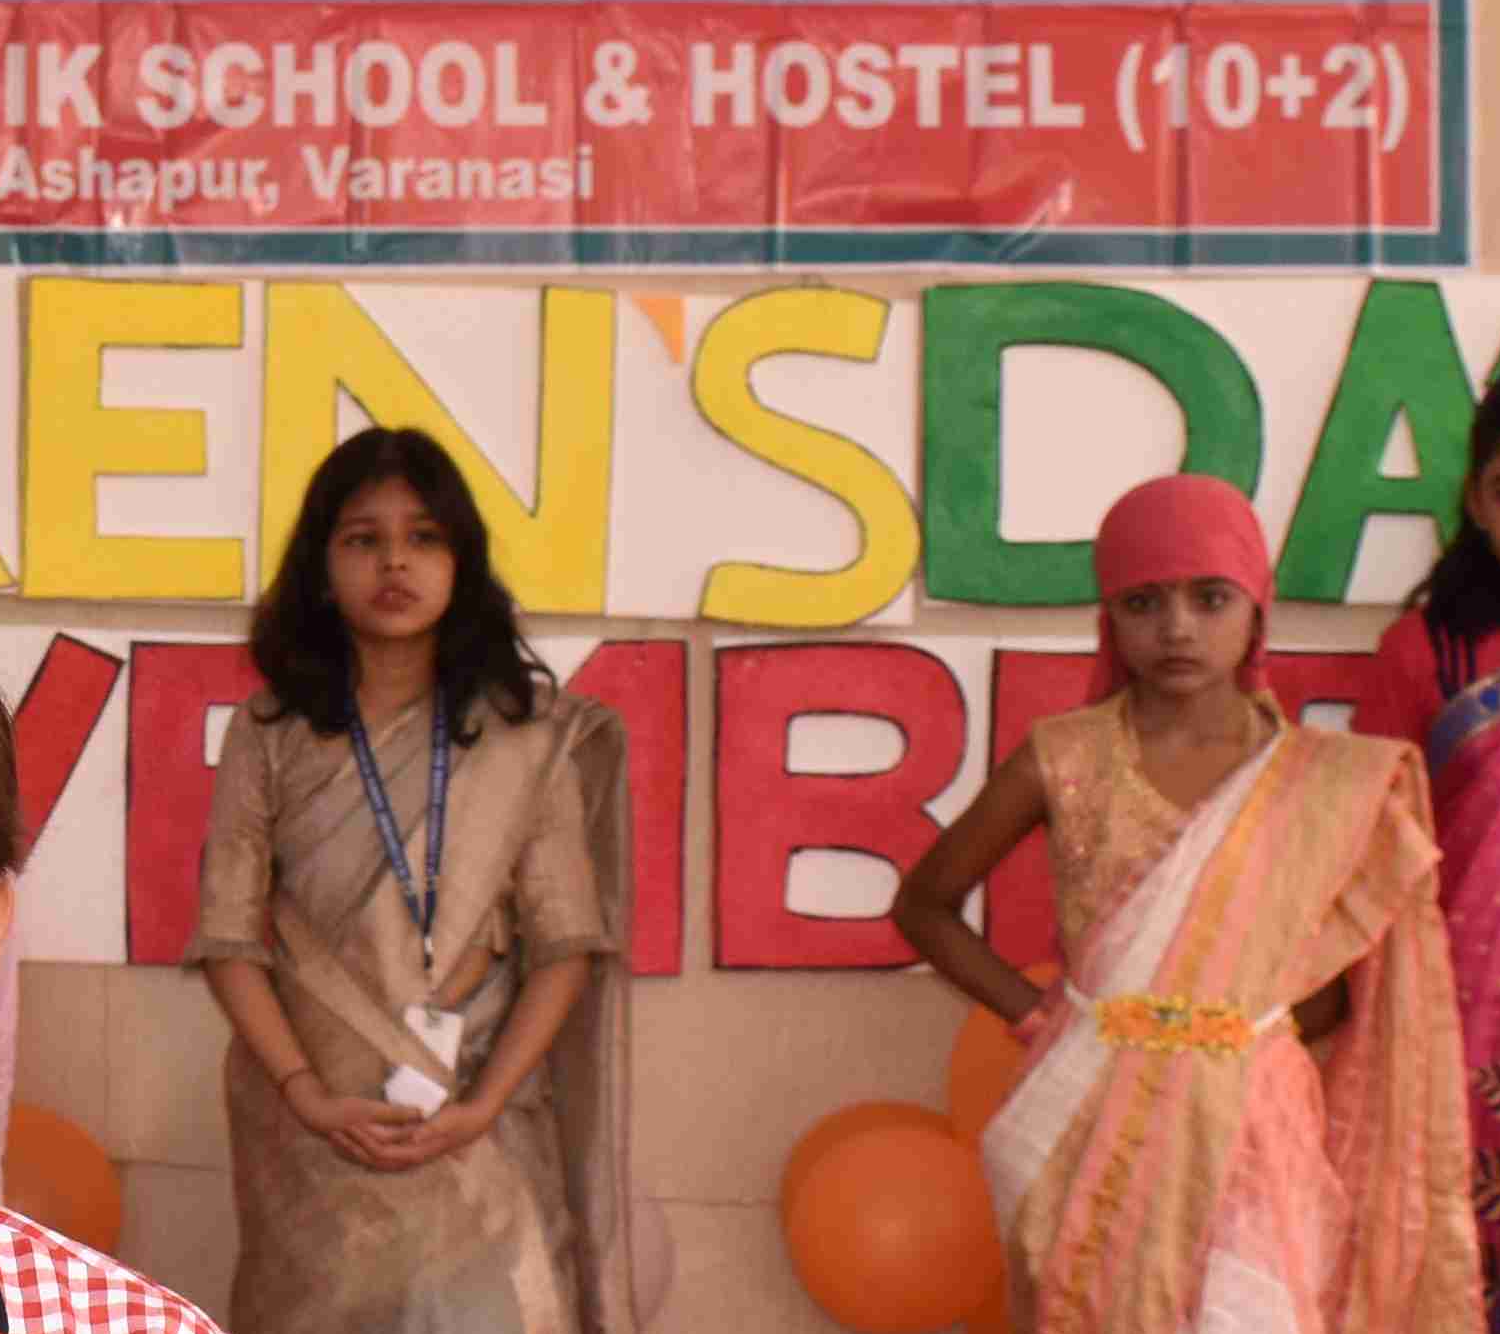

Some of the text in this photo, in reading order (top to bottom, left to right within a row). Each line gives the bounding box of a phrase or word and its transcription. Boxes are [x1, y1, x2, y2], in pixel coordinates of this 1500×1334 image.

[136, 41, 549, 129] SCHOOL
[583, 41, 653, 126] &
[690, 41, 1085, 129] HOSTEL
[1115, 42, 1409, 153] (10+2)
[0, 145, 280, 211] Ashapur,
[301, 144, 595, 200] Varanasi
